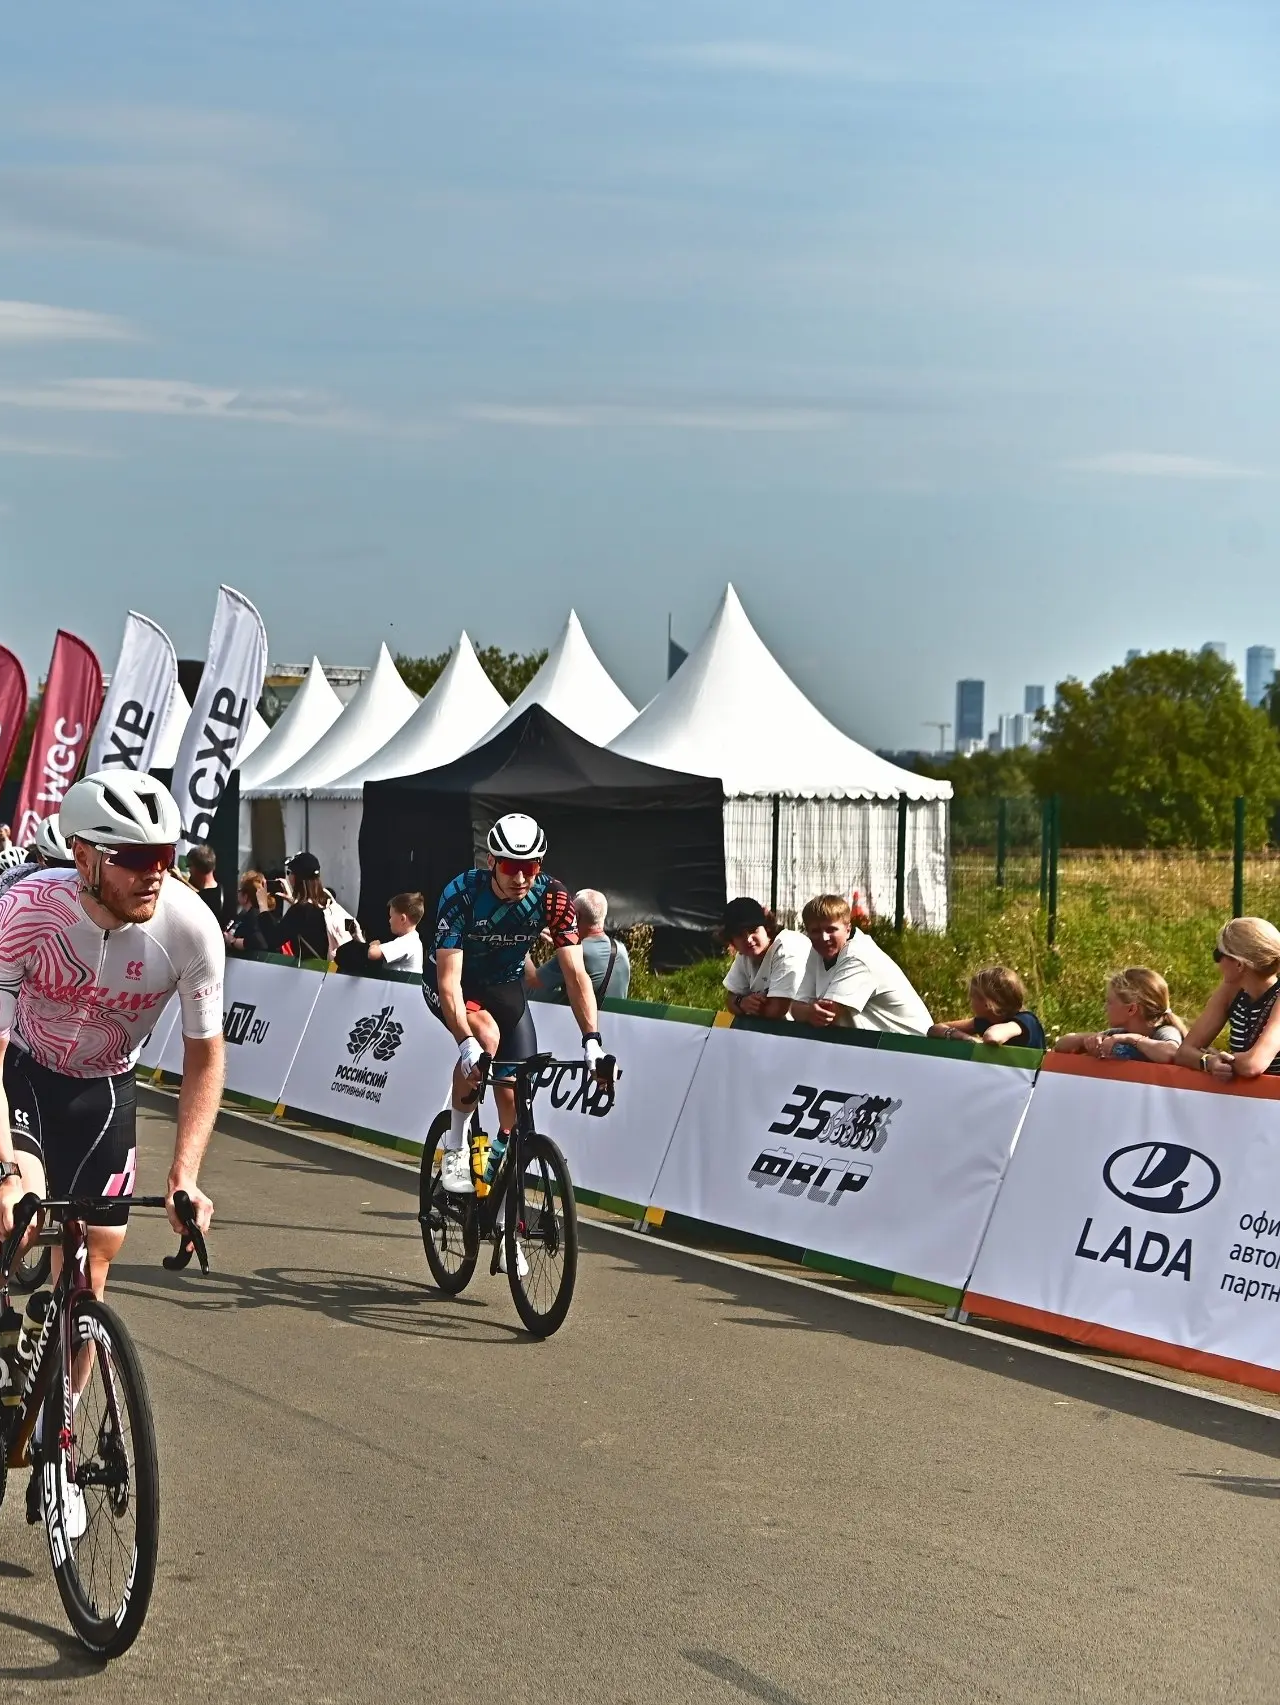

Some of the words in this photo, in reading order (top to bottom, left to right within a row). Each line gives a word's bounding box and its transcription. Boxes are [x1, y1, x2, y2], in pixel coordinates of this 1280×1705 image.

[331, 1081, 367, 1099] СПОРТИВНЫЙ
[365, 1090, 382, 1104] ФОНД
[335, 1064, 388, 1089] РОССИЙСКИЙ
[768, 1084, 862, 1140] 35
[1074, 1217, 1193, 1282] LADA
